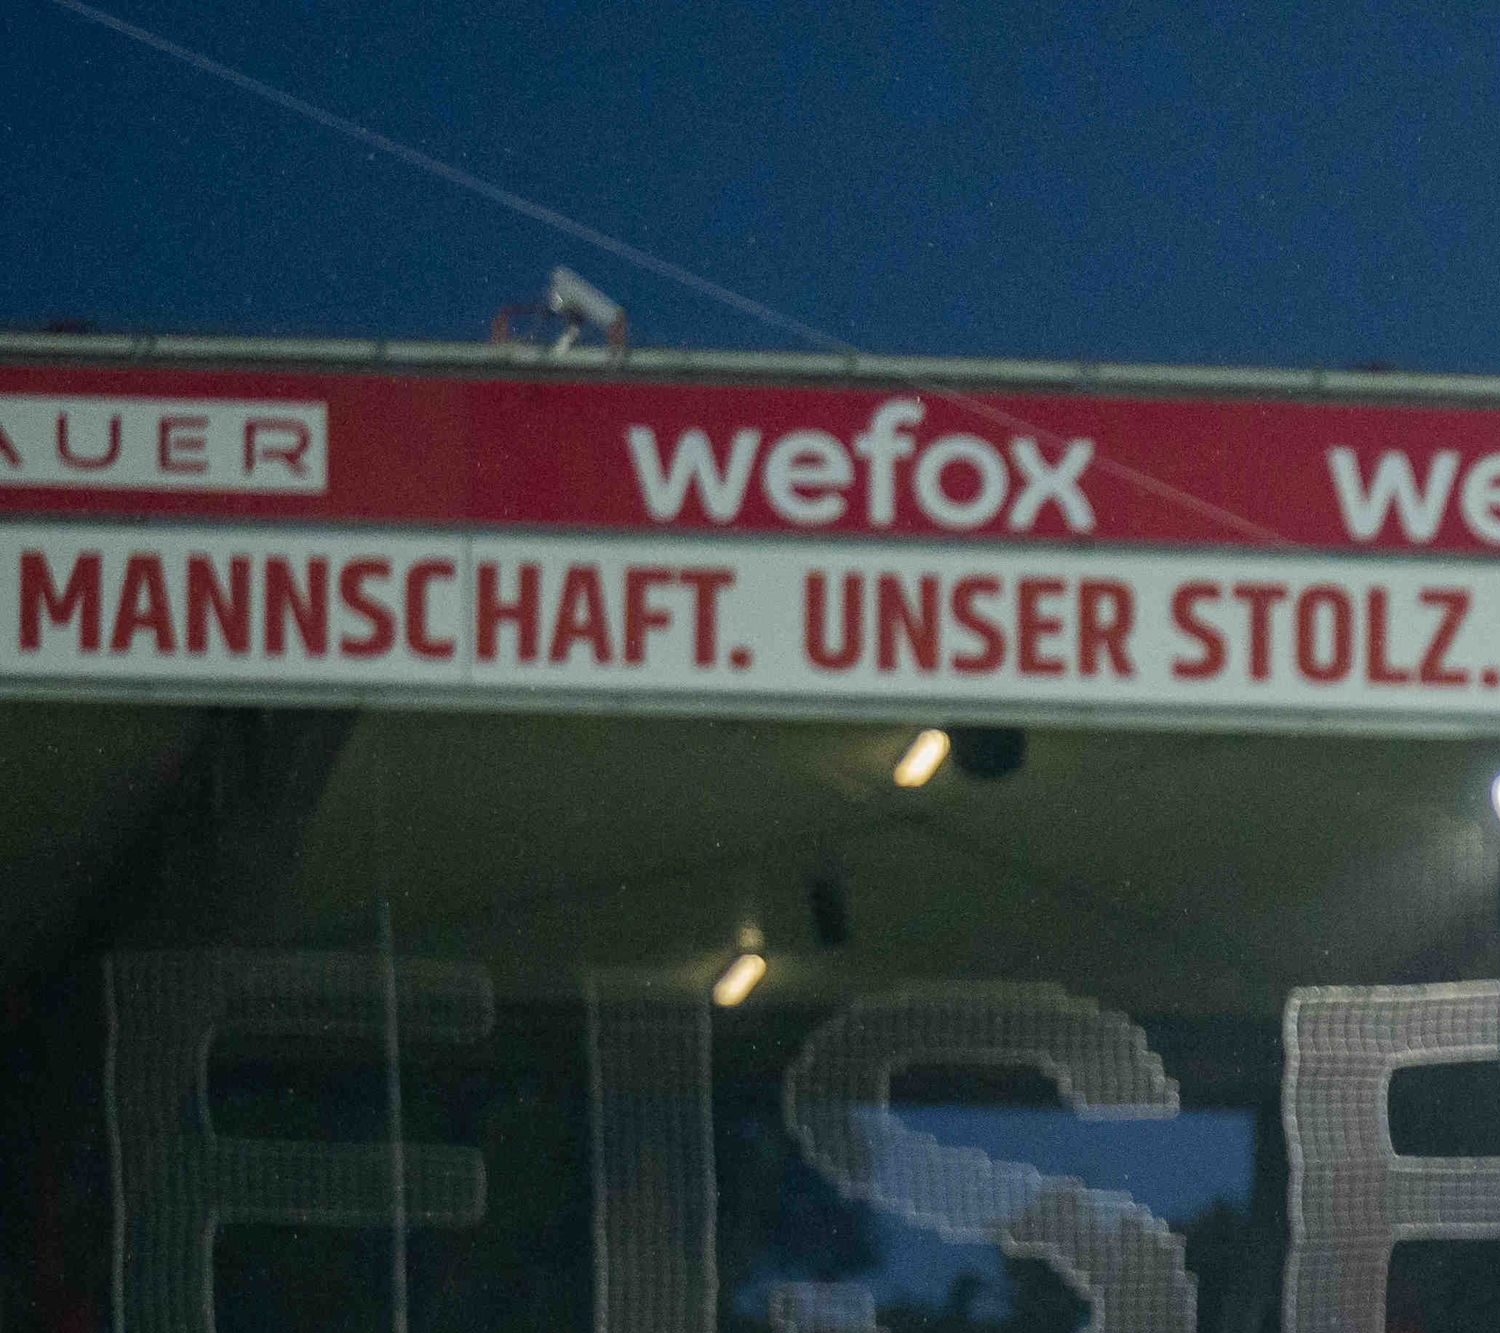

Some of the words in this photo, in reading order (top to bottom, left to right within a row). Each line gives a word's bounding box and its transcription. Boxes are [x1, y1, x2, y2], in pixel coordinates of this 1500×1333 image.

[628, 401, 1095, 532] wefox
[17, 548, 752, 671] MANNSCHAFT.
[803, 570, 1136, 679] UNSER
